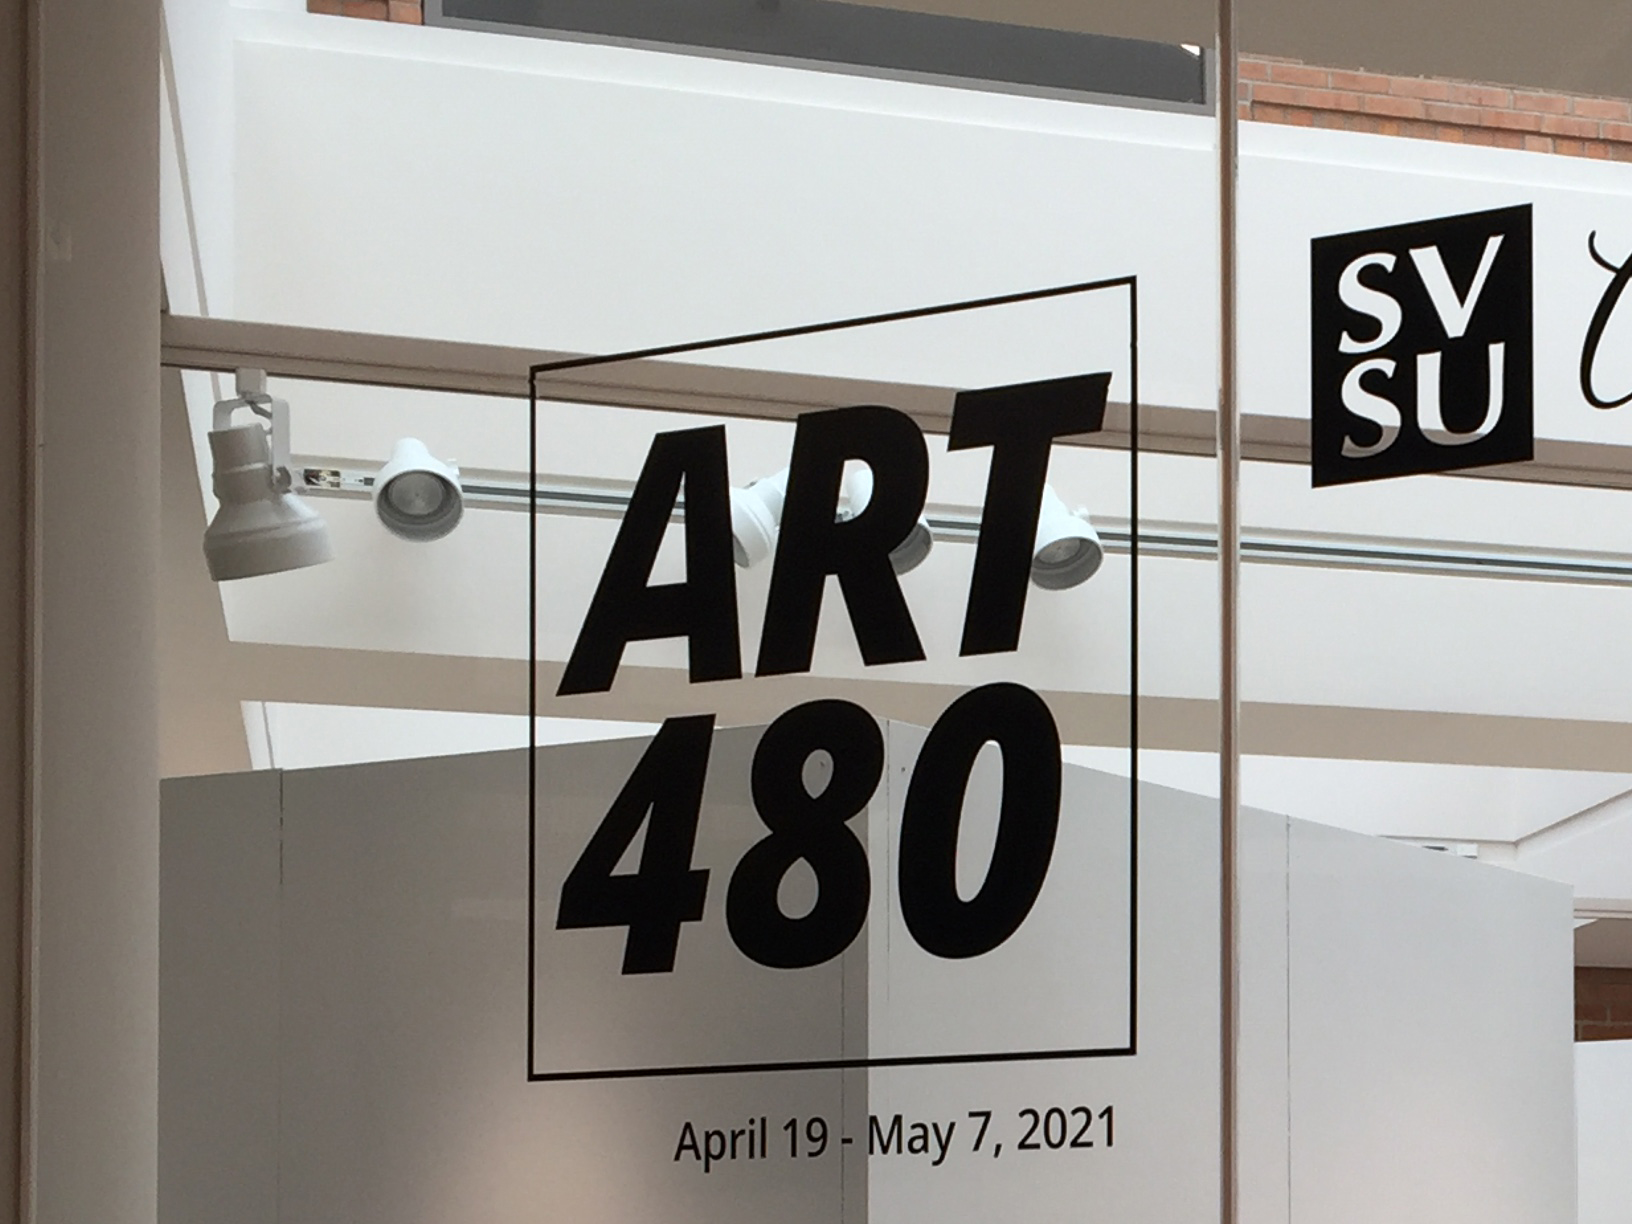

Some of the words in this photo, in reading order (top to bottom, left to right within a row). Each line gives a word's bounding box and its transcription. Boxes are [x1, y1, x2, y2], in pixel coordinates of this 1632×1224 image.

[555, 371, 1113, 696] ART
[555, 681, 1063, 976] 480
[673, 1116, 768, 1174] April
[782, 1116, 829, 1158] 19
[867, 1112, 956, 1167] May
[967, 1110, 1003, 1159] 7,
[1017, 1105, 1115, 1151] 2021
